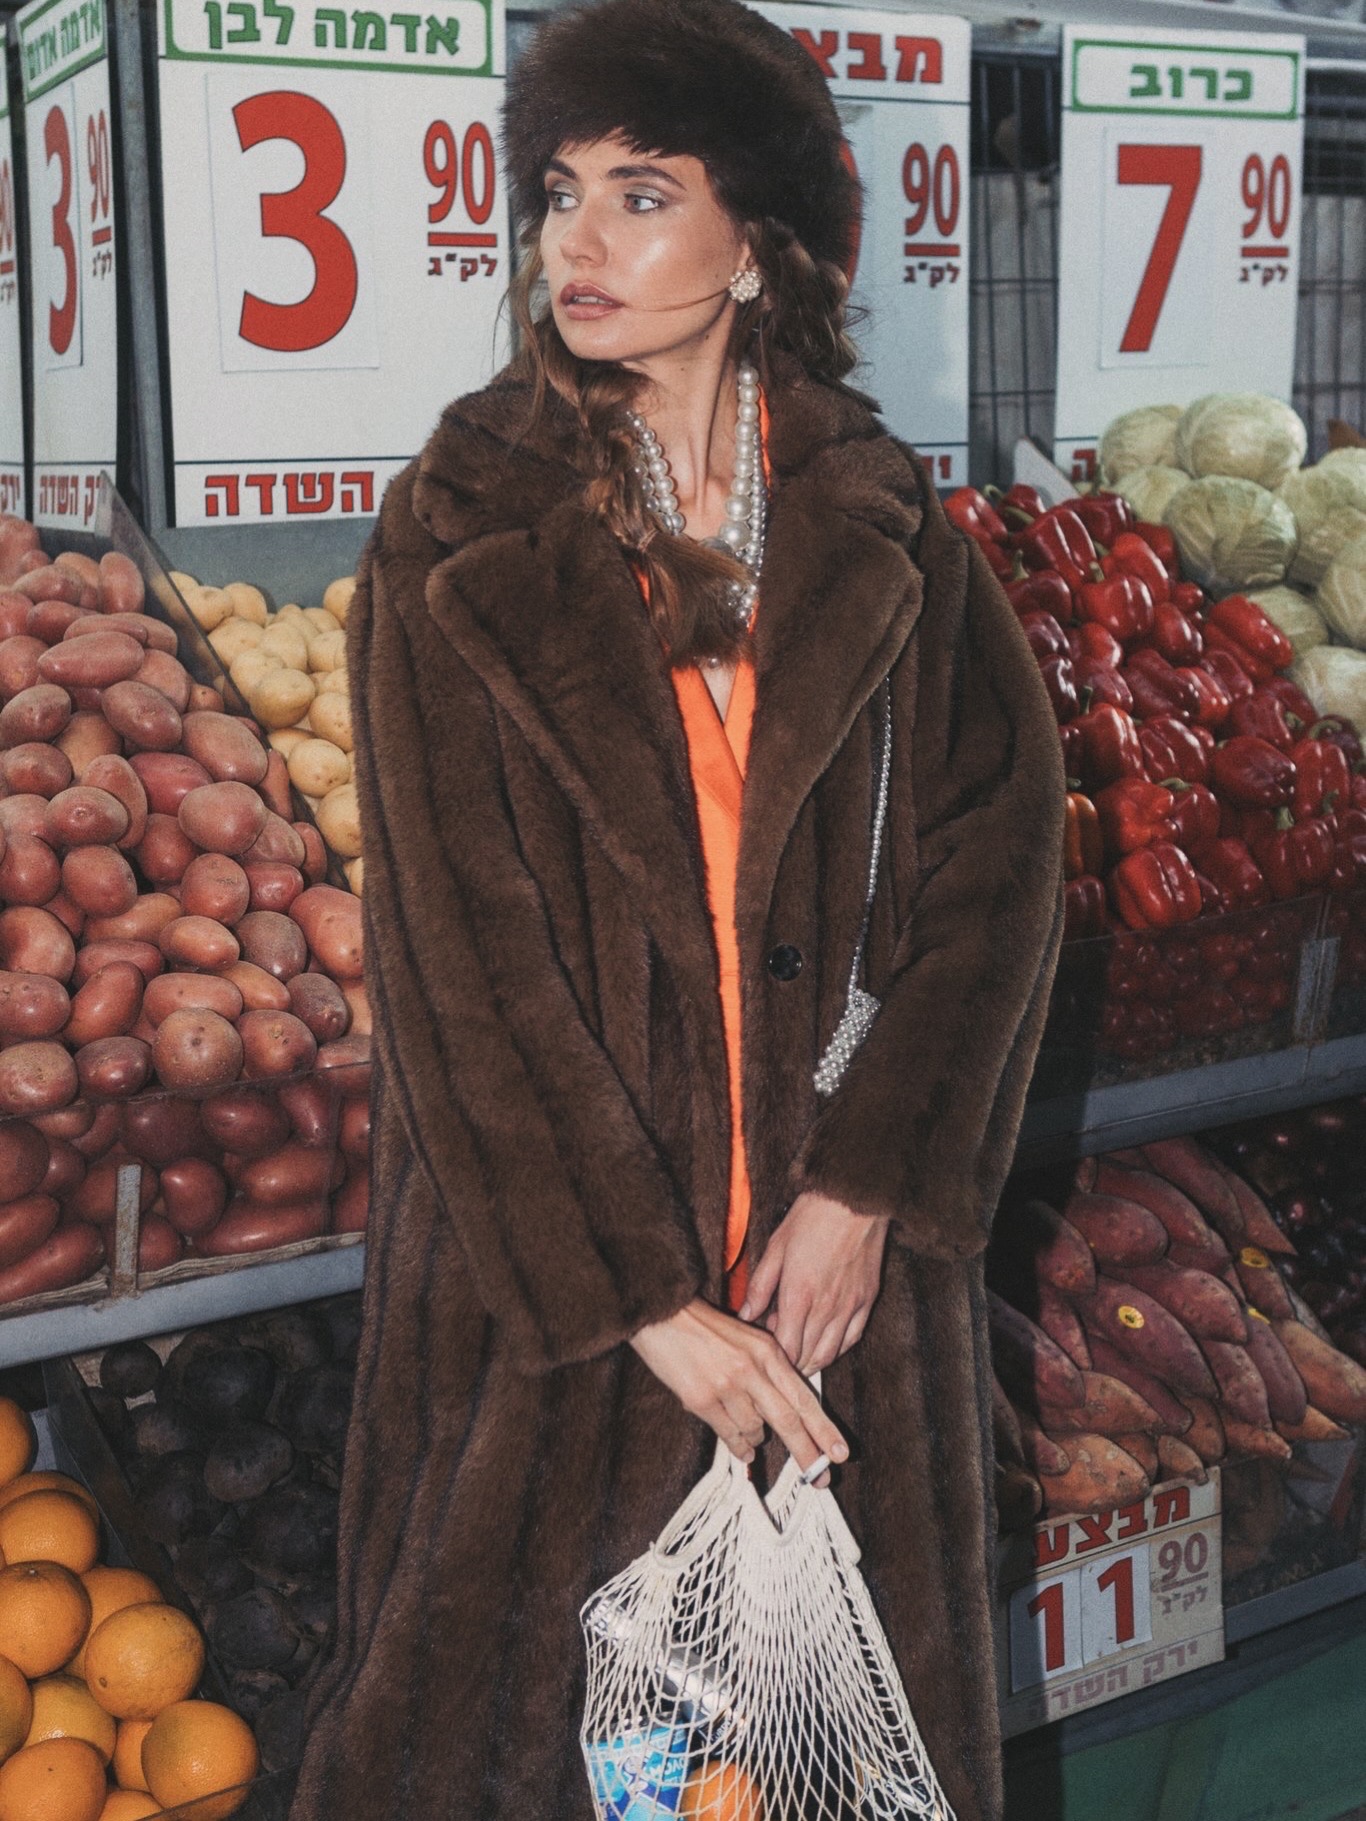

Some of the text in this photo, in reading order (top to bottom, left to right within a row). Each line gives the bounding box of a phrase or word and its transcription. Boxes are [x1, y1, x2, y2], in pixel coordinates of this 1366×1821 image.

[204, 0, 461, 57] אדמה לבן
[789, 27, 944, 84] מבצ
[1130, 63, 1254, 102] כרוב
[87, 109, 110, 224] 90
[423, 119, 497, 225] 90
[902, 142, 961, 238] 90
[232, 90, 359, 352] 3
[1241, 153, 1292, 240] 90
[44, 105, 78, 355] 3
[1117, 143, 1203, 353] 7
[427, 252, 498, 282] לק"ג
[903, 261, 961, 289] לק"ג
[1239, 262, 1290, 287] לק"ג
[39, 474, 79, 516] השדה
[204, 470, 375, 518] השדה
[1034, 1485, 1191, 1567] מבצע
[1158, 1531, 1209, 1583] 90
[1027, 1555, 1136, 1673] 11
[1142, 1639, 1199, 1685] ירק
